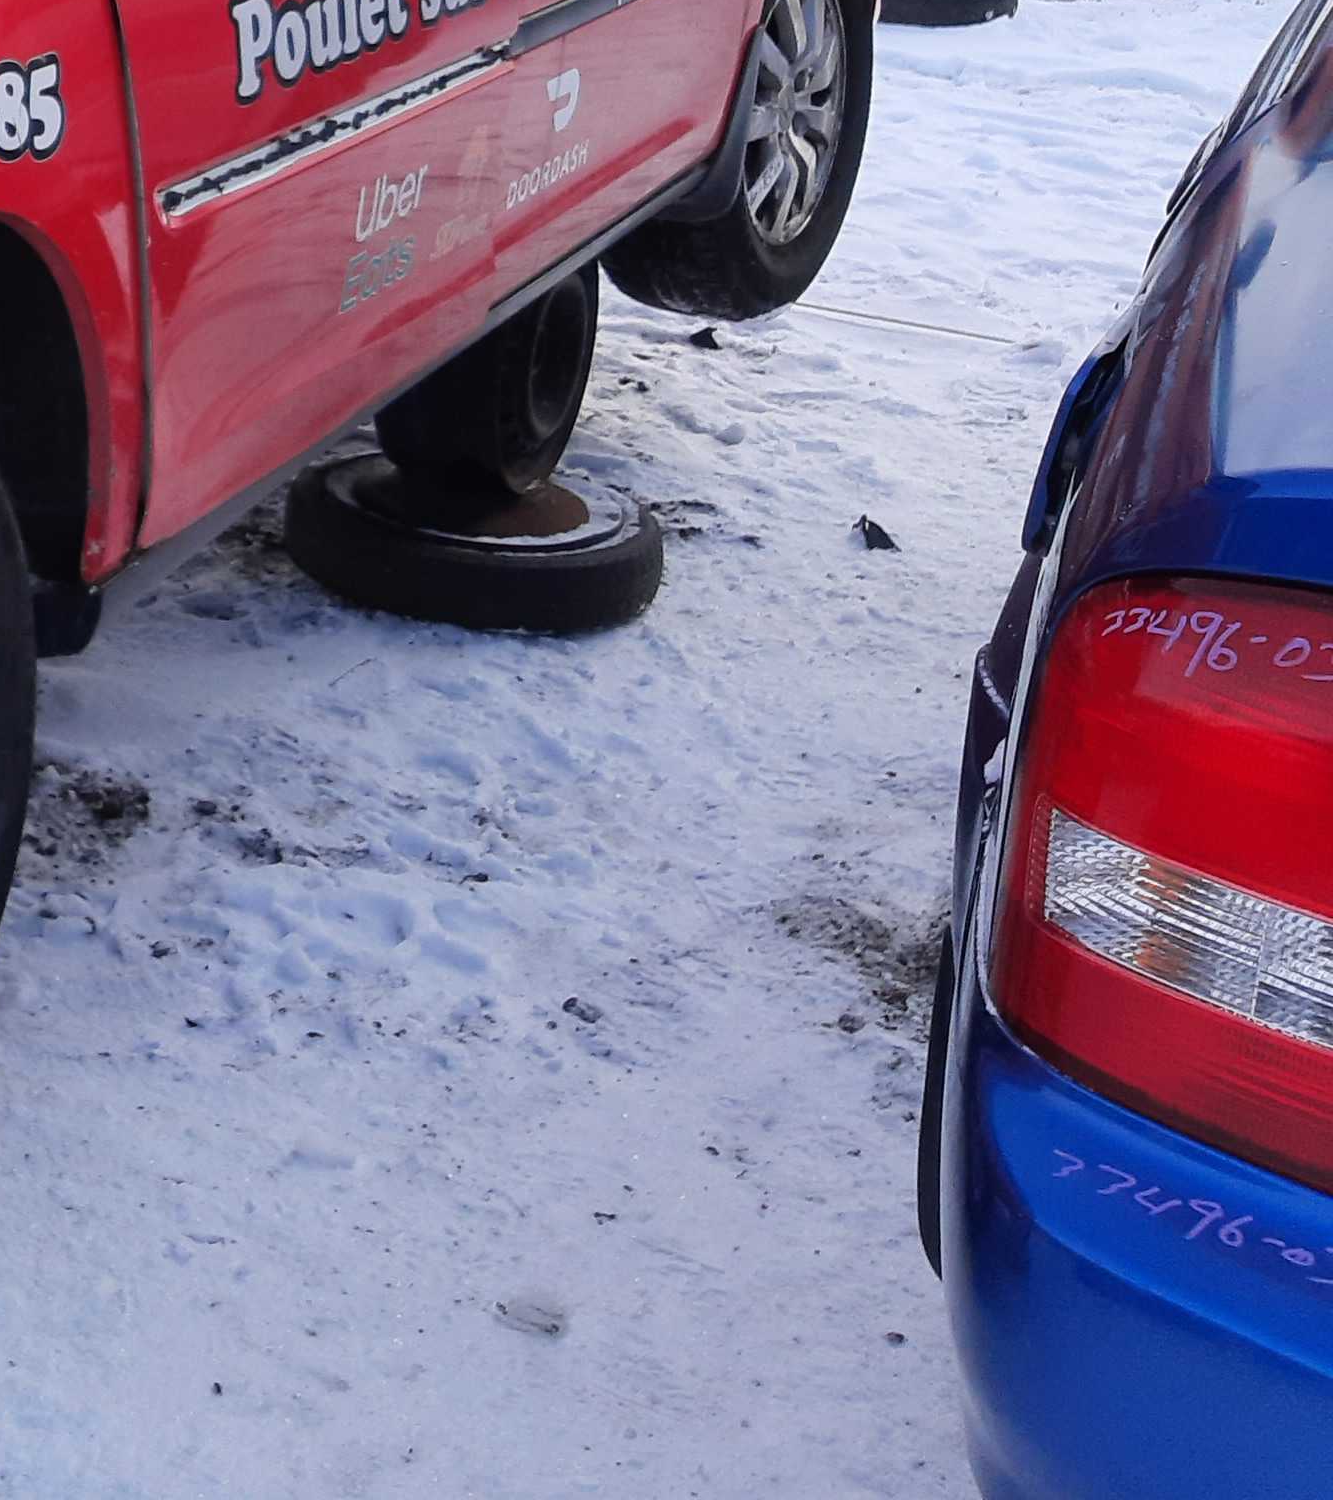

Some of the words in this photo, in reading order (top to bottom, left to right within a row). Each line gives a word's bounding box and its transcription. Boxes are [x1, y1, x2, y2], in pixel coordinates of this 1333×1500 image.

[354, 163, 429, 243] Uber
[505, 139, 590, 211] DOORDASH
[338, 235, 417, 315] Eats
